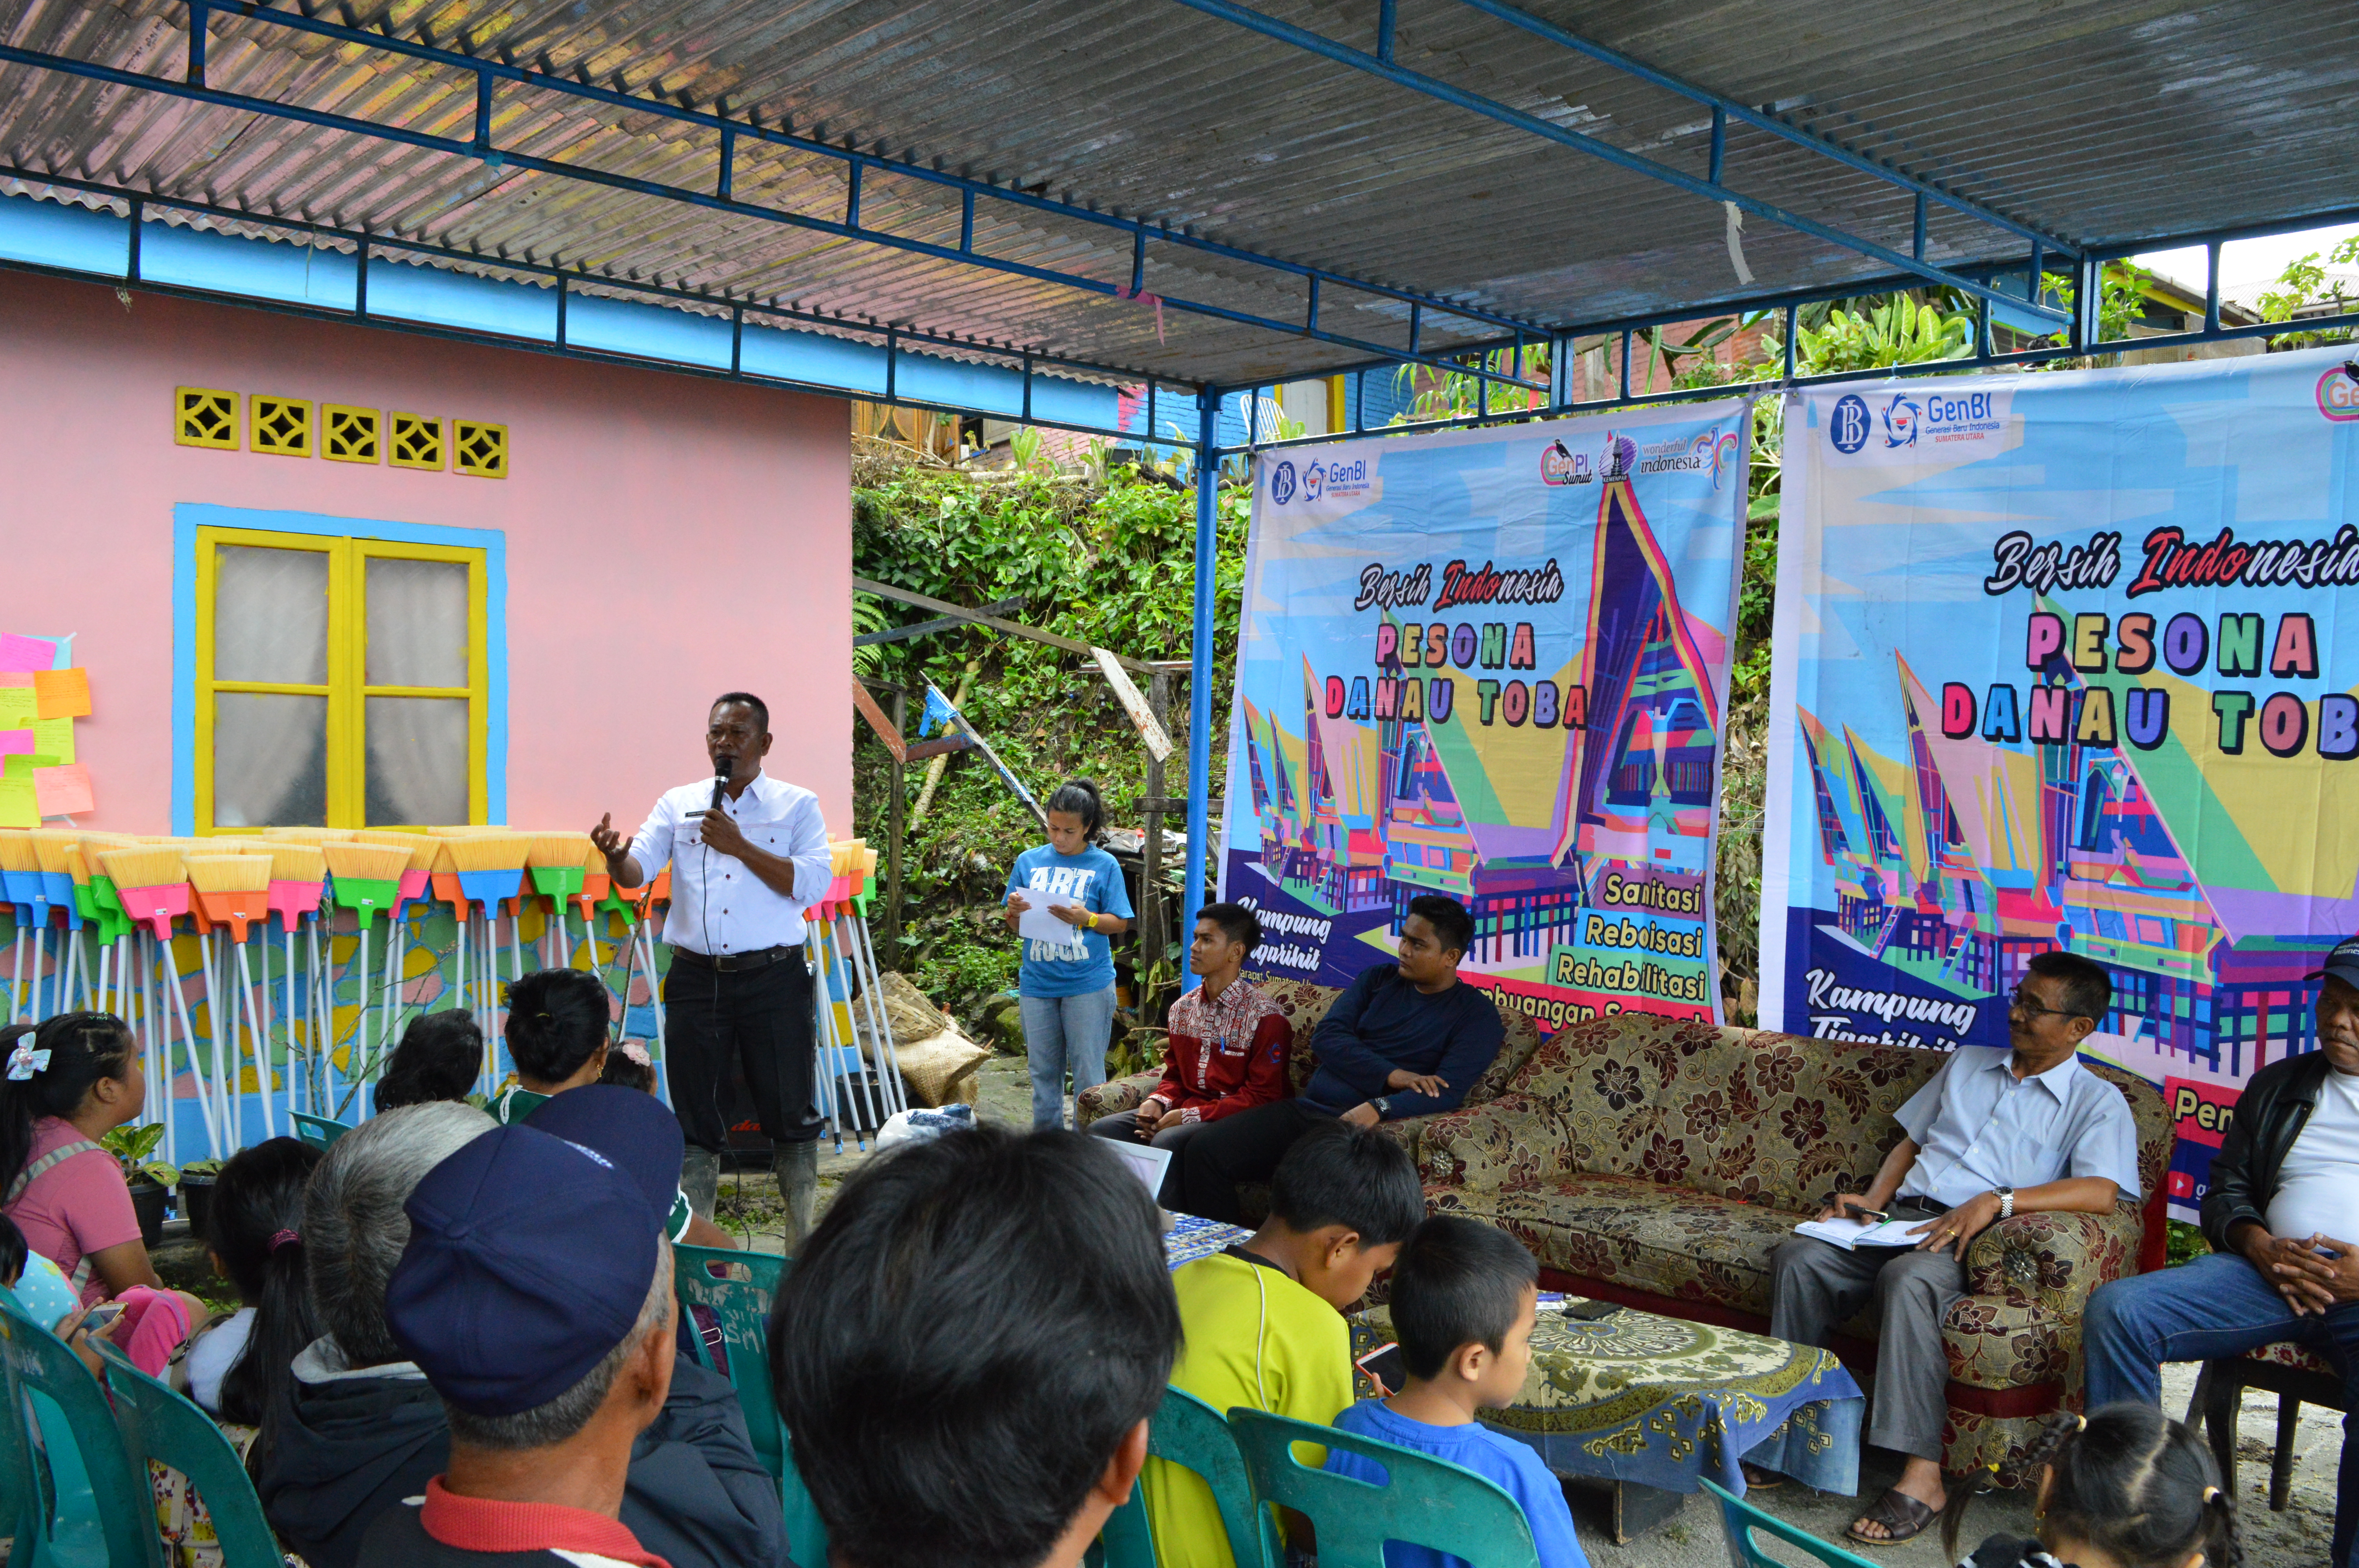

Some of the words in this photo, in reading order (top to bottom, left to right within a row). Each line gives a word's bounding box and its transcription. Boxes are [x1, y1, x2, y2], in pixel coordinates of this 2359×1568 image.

[1926, 425, 1952, 434] Generasi
[1953, 423, 1967, 432] Baru
[1969, 421, 1999, 431] Indonesia
[1928, 392, 1992, 423] GenBI
[1643, 437, 1687, 455] wonderful
[1935, 434, 1965, 442] SUMATERA
[1330, 460, 1366, 483] GenBI
[1547, 454, 1588, 475] GenPI
[1563, 469, 1592, 485] Sumut
[1641, 455, 1701, 473] indonesia
[1985, 531, 2121, 596] Bersih
[1355, 563, 1431, 610] Bersih
[1434, 559, 1564, 612] Indonesia
[1376, 623, 1536, 670] PESONA
[2026, 613, 2319, 679] PESONA
[1326, 675, 1454, 724] DANAU
[1478, 679, 1588, 730] TOBA
[1942, 682, 2168, 750] DANAU
[2212, 690, 2359, 760] TOB
[1604, 873, 1701, 914] Sanitasi
[1250, 934, 1320, 971] garihit
[1585, 915, 1703, 958] Reboisasi
[1239, 968, 1264, 983] arapat,
[1557, 953, 1706, 1001] Rehabilitasi
[1476, 983, 1597, 1032] buangan
[1805, 969, 1977, 1036] Kampung
